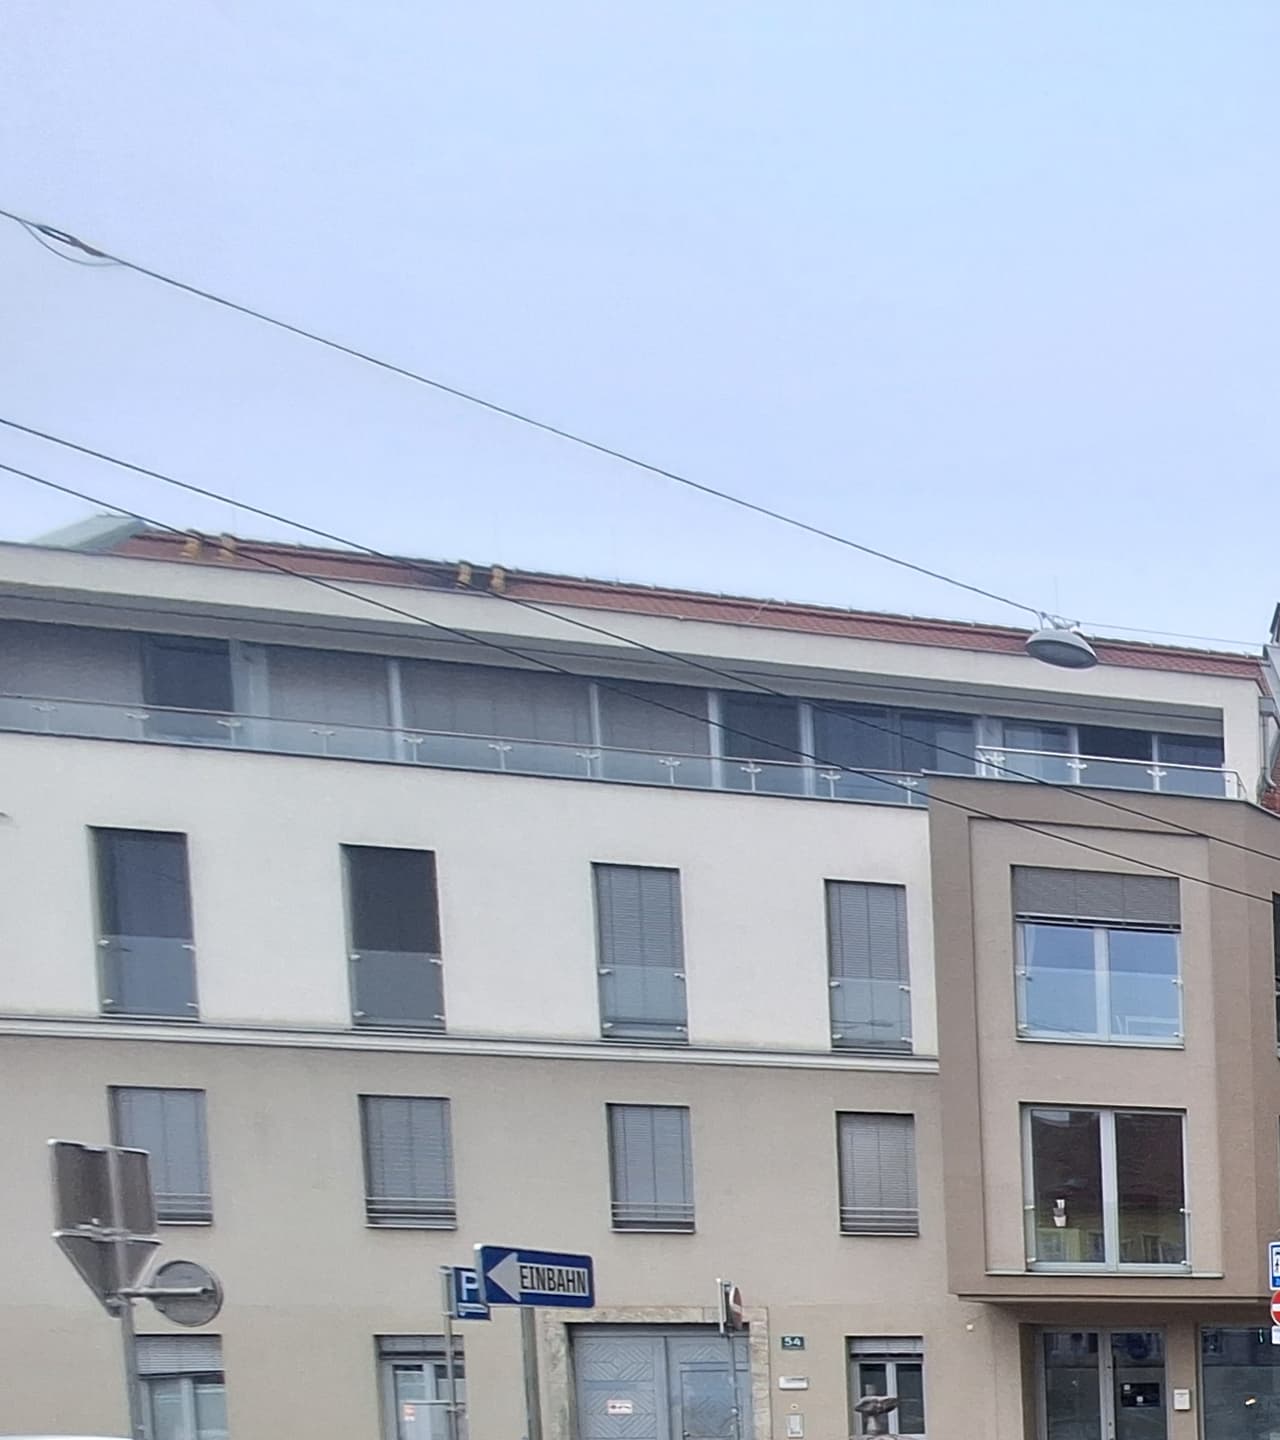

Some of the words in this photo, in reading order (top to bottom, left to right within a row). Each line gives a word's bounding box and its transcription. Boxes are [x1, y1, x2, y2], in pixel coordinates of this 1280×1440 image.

[461, 1271, 479, 1300] P
[519, 1265, 587, 1294] EINBAHN
[783, 1337, 801, 1346] 54
